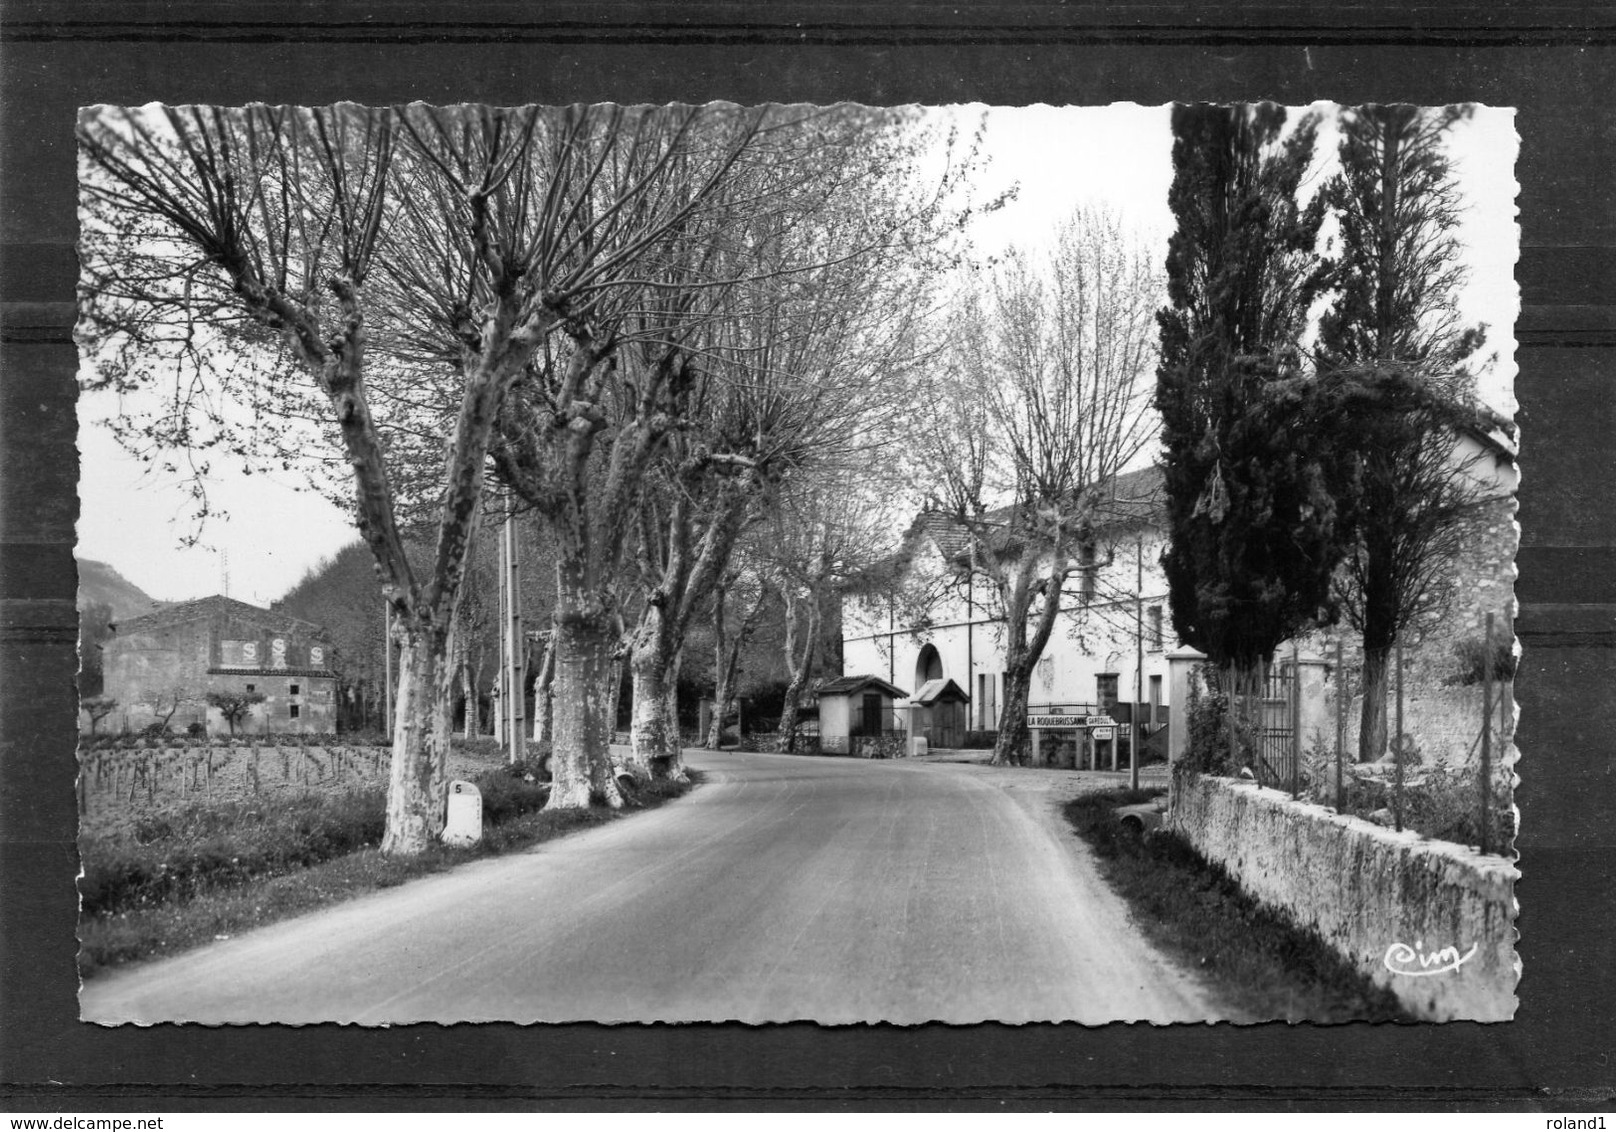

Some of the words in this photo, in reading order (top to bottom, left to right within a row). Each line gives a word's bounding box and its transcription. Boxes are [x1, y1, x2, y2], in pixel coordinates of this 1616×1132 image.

[1028, 717, 1036, 726] LA
[1037, 716, 1087, 726] ROQUEBRUSSANNE
[455, 784, 462, 794] 5
